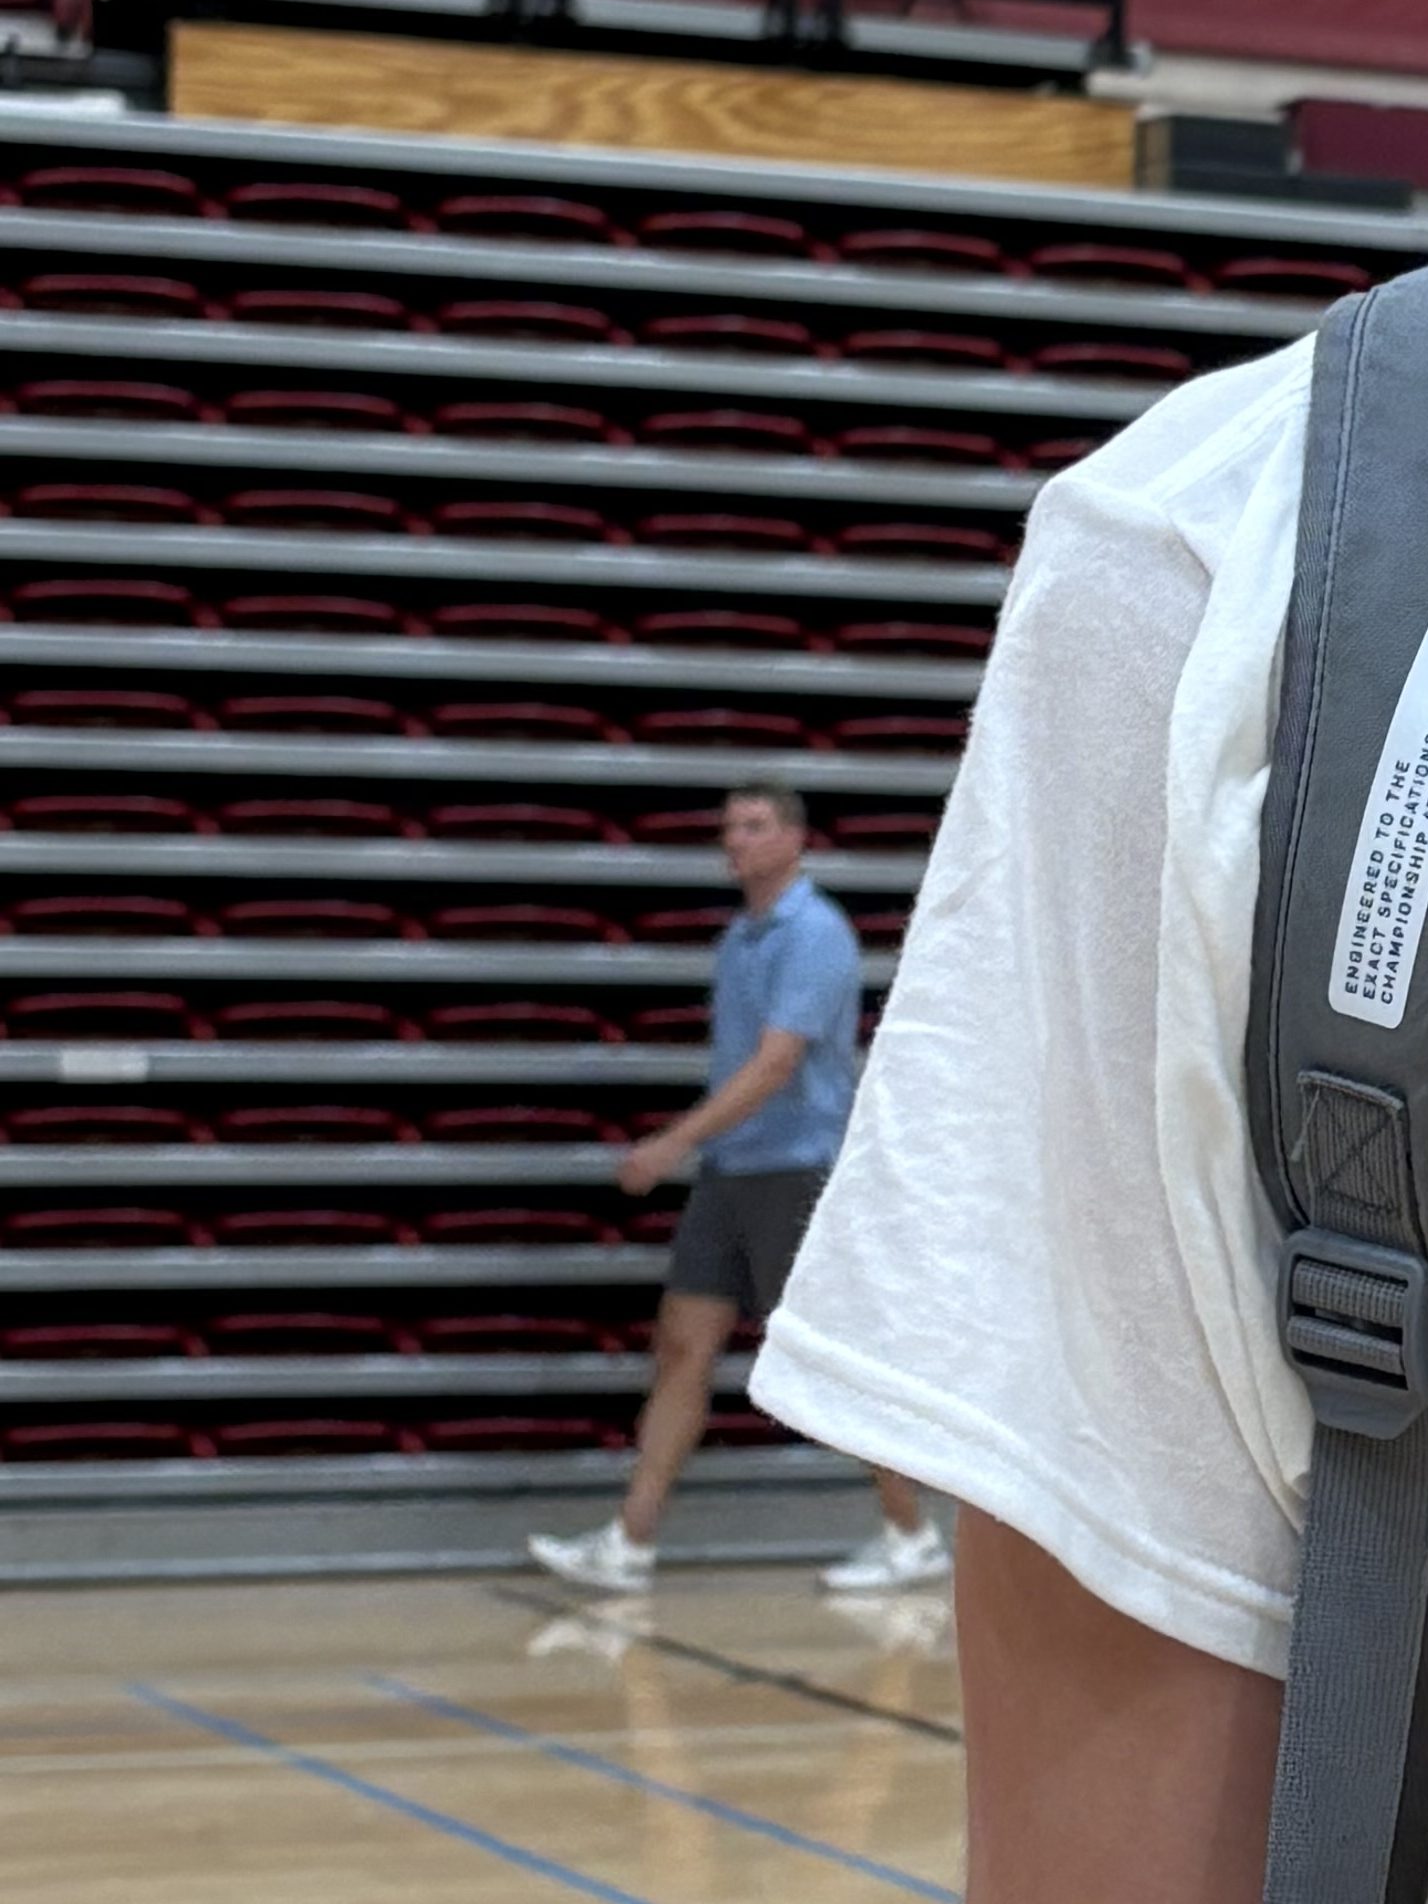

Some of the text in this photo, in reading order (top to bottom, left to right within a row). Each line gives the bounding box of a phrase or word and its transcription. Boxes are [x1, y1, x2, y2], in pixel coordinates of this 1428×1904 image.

[1345, 760, 1410, 994] ENGINEERED TO THE
[1363, 927, 1386, 999] EXACT
[1381, 831, 1428, 1004] CHAMPIONSHIP
